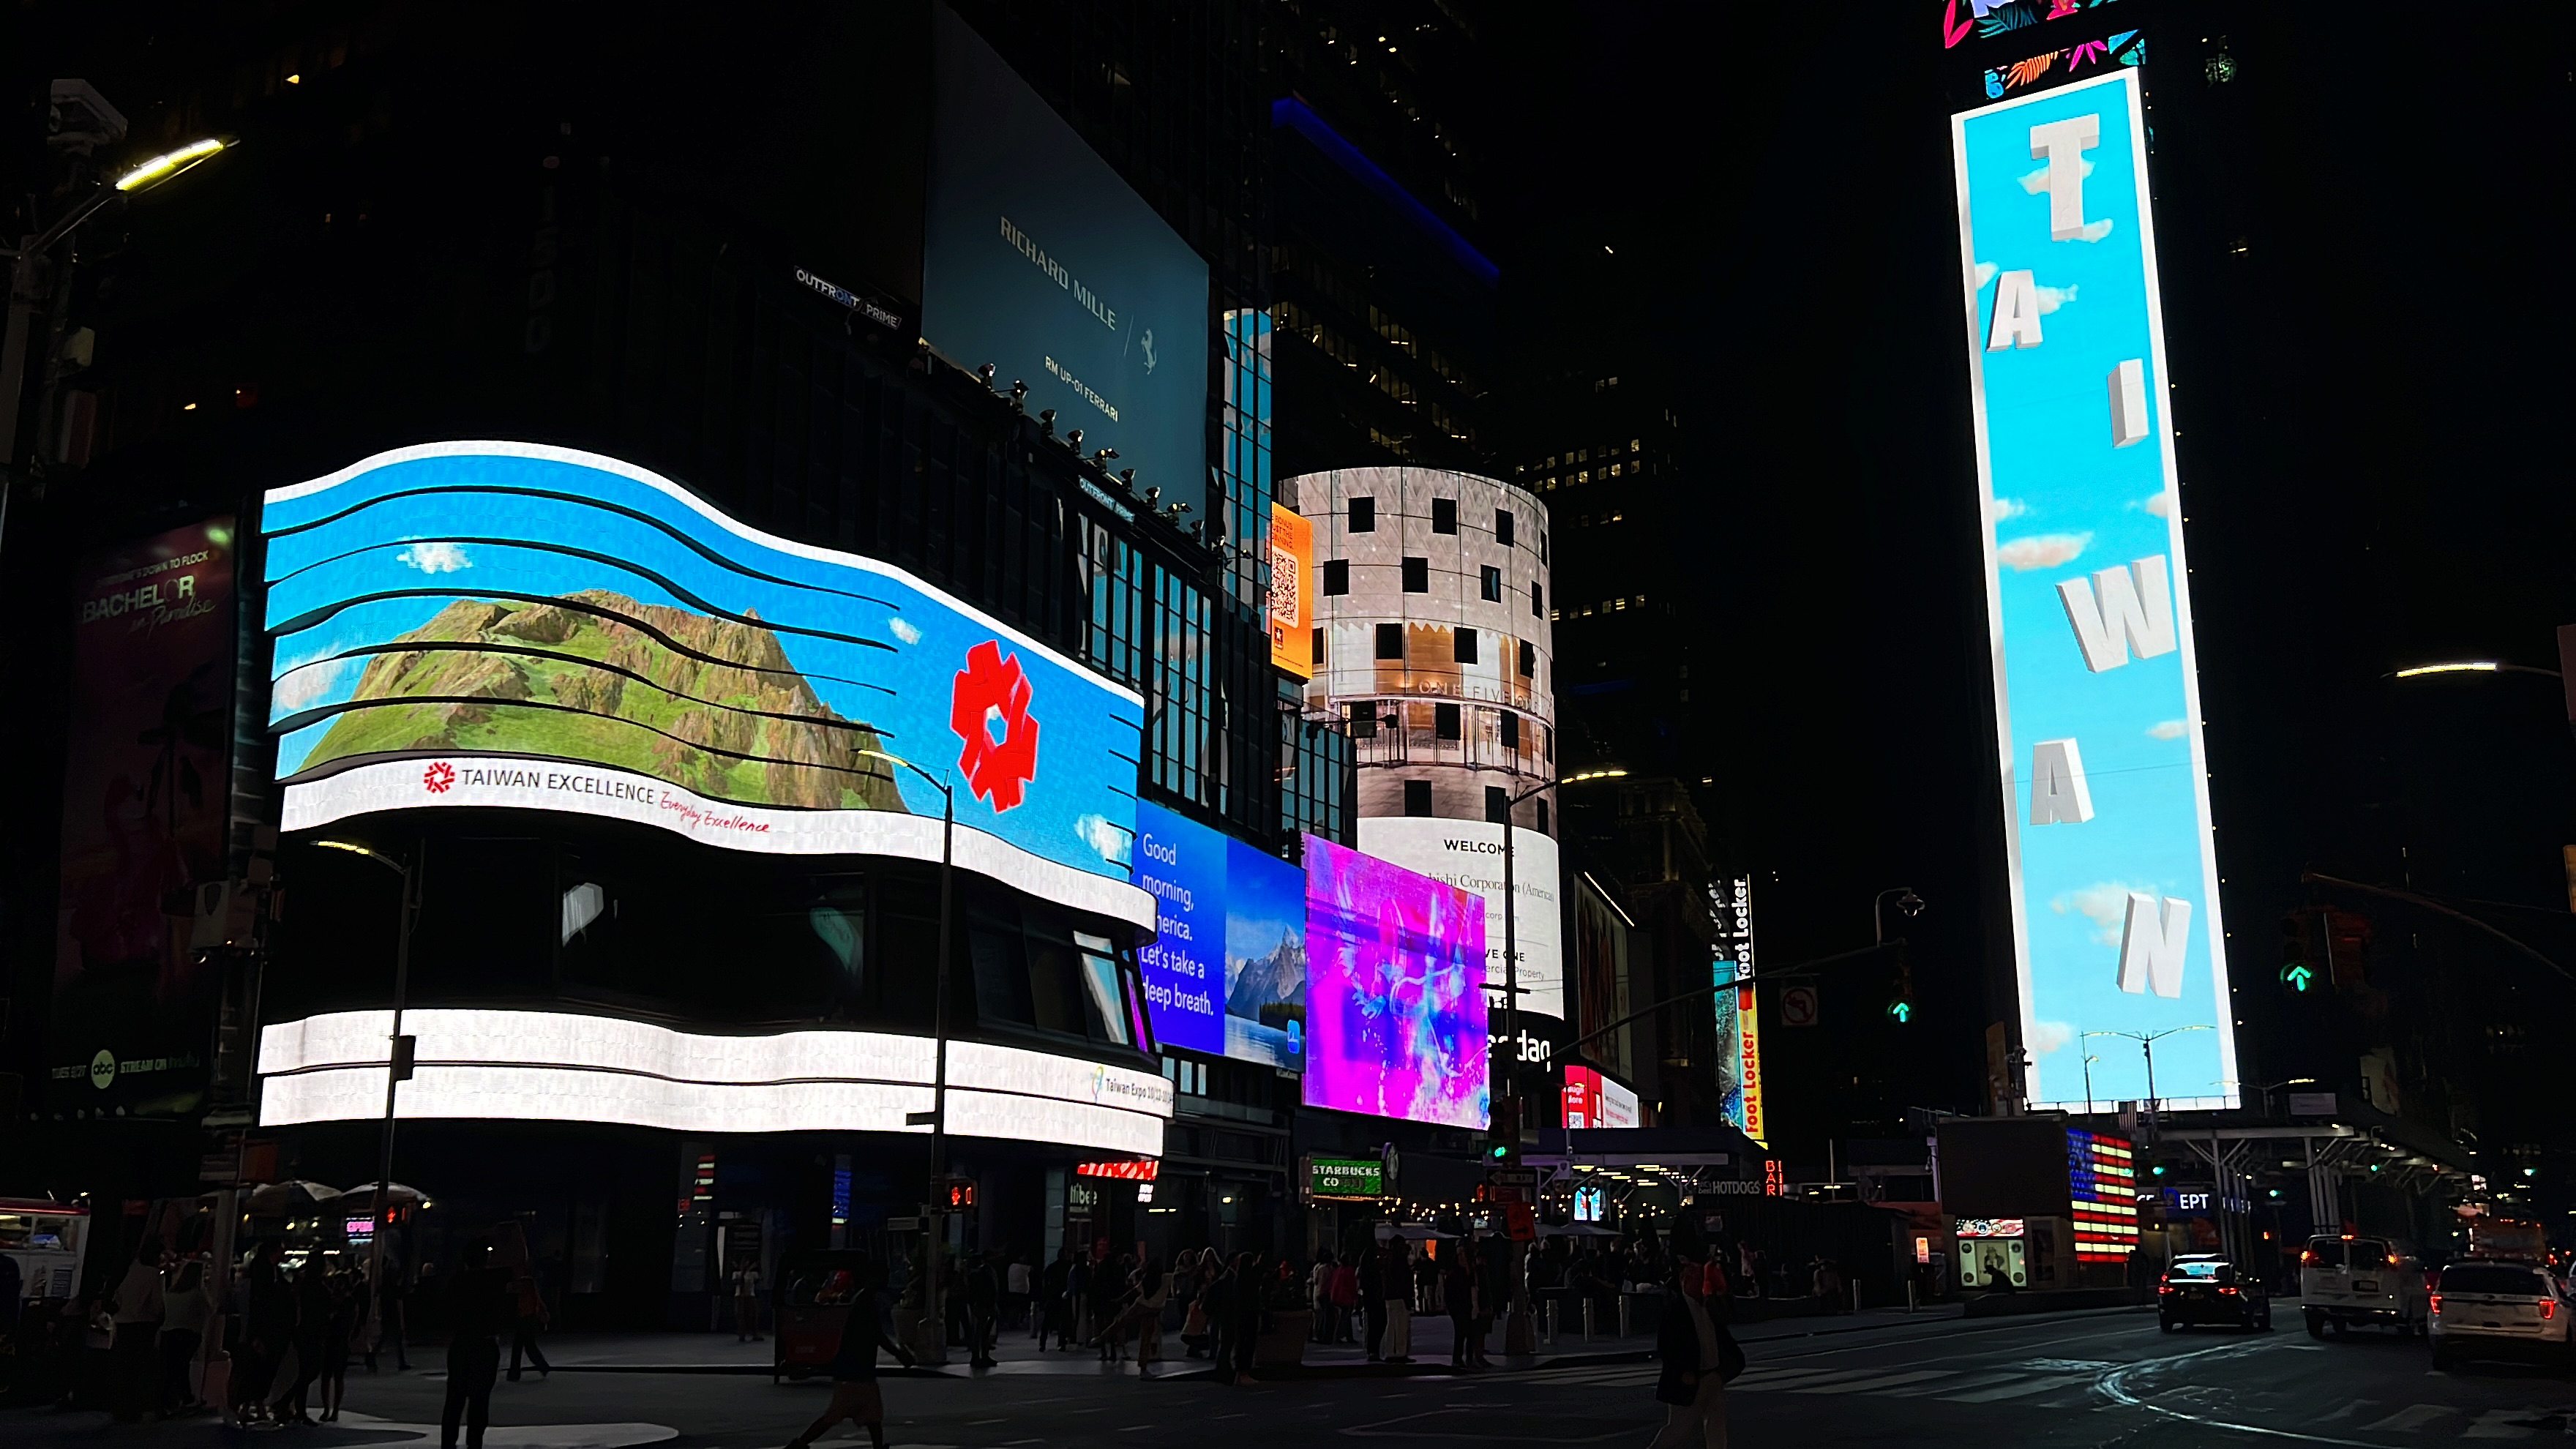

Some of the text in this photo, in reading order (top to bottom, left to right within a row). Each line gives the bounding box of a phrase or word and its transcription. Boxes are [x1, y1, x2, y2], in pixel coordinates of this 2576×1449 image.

[1000, 216, 1115, 331] RICHARD MILLE
[796, 269, 897, 327] OUTFRONT PRIME
[1045, 356, 1118, 423] RM UP-01 FERRARI
[170, 558, 181, 569] TO
[181, 550, 209, 566] FLOCK
[81, 575, 195, 624] BACHELOR
[463, 769, 771, 833] TAIWAN EXCELLENCE Everyday Excellence
[1142, 833, 1176, 866] Good
[1142, 874, 1194, 912] morning,
[1461, 875, 1520, 893] Corporan
[1731, 878, 1750, 937] Locker
[1142, 944, 1205, 979] Let's take a
[1175, 983, 1213, 1016] breath.
[94, 1063, 113, 1074] abc
[1742, 1032, 1759, 1133] Foot Locker
[1107, 1078, 1129, 1095] Taiwan
[1131, 1083, 1146, 1100] Expo
[1312, 1165, 1380, 1177] STARBUCKS
[1712, 1180, 1761, 1194] HOTDOGS
[1765, 1160, 1777, 1197] BAR
[2179, 1194, 2209, 1210] EPT
